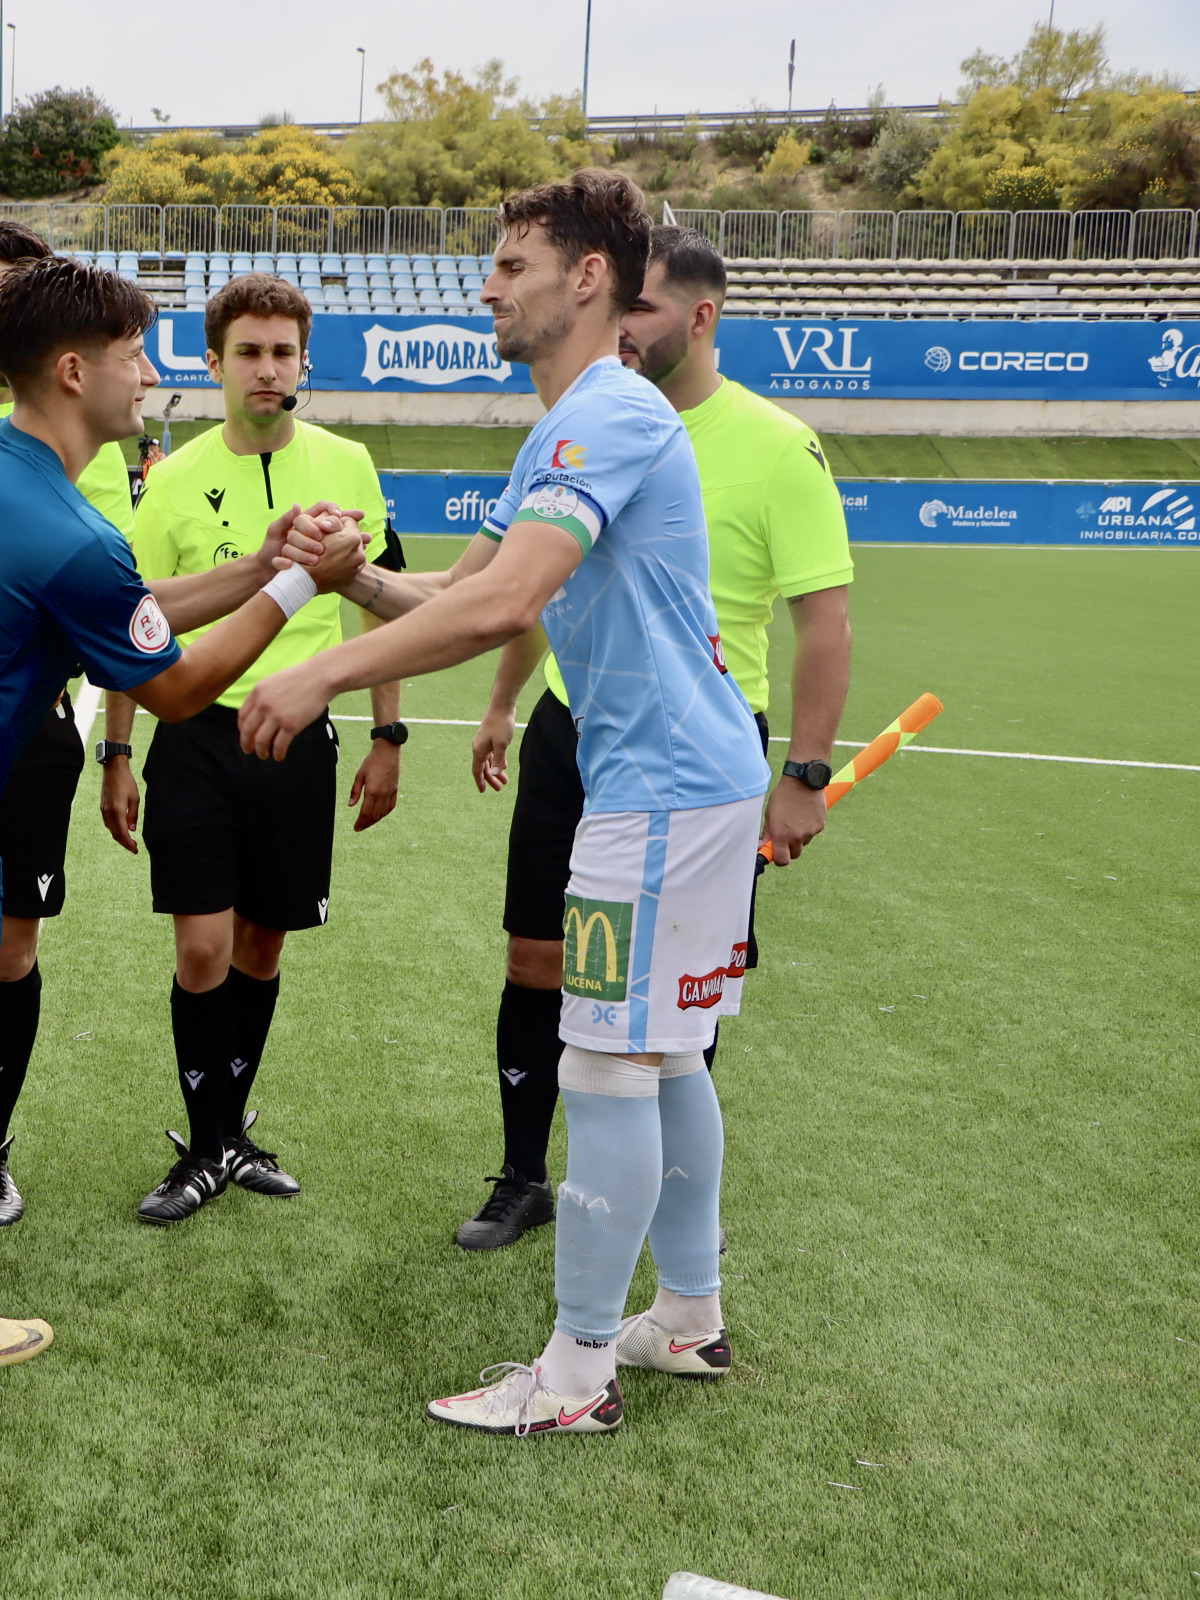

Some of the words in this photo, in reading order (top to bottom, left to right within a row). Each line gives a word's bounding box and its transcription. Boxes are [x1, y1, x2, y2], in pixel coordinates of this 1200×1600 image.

[378, 339, 502, 370] CAMPOARAS
[773, 326, 872, 371] VRL
[958, 351, 1089, 372] CORECO
[769, 379, 870, 391] ABOGADOS
[947, 506, 1018, 519] Madelea
[1097, 515, 1173, 526] URBANA
[576, 1338, 609, 1349] umbro
